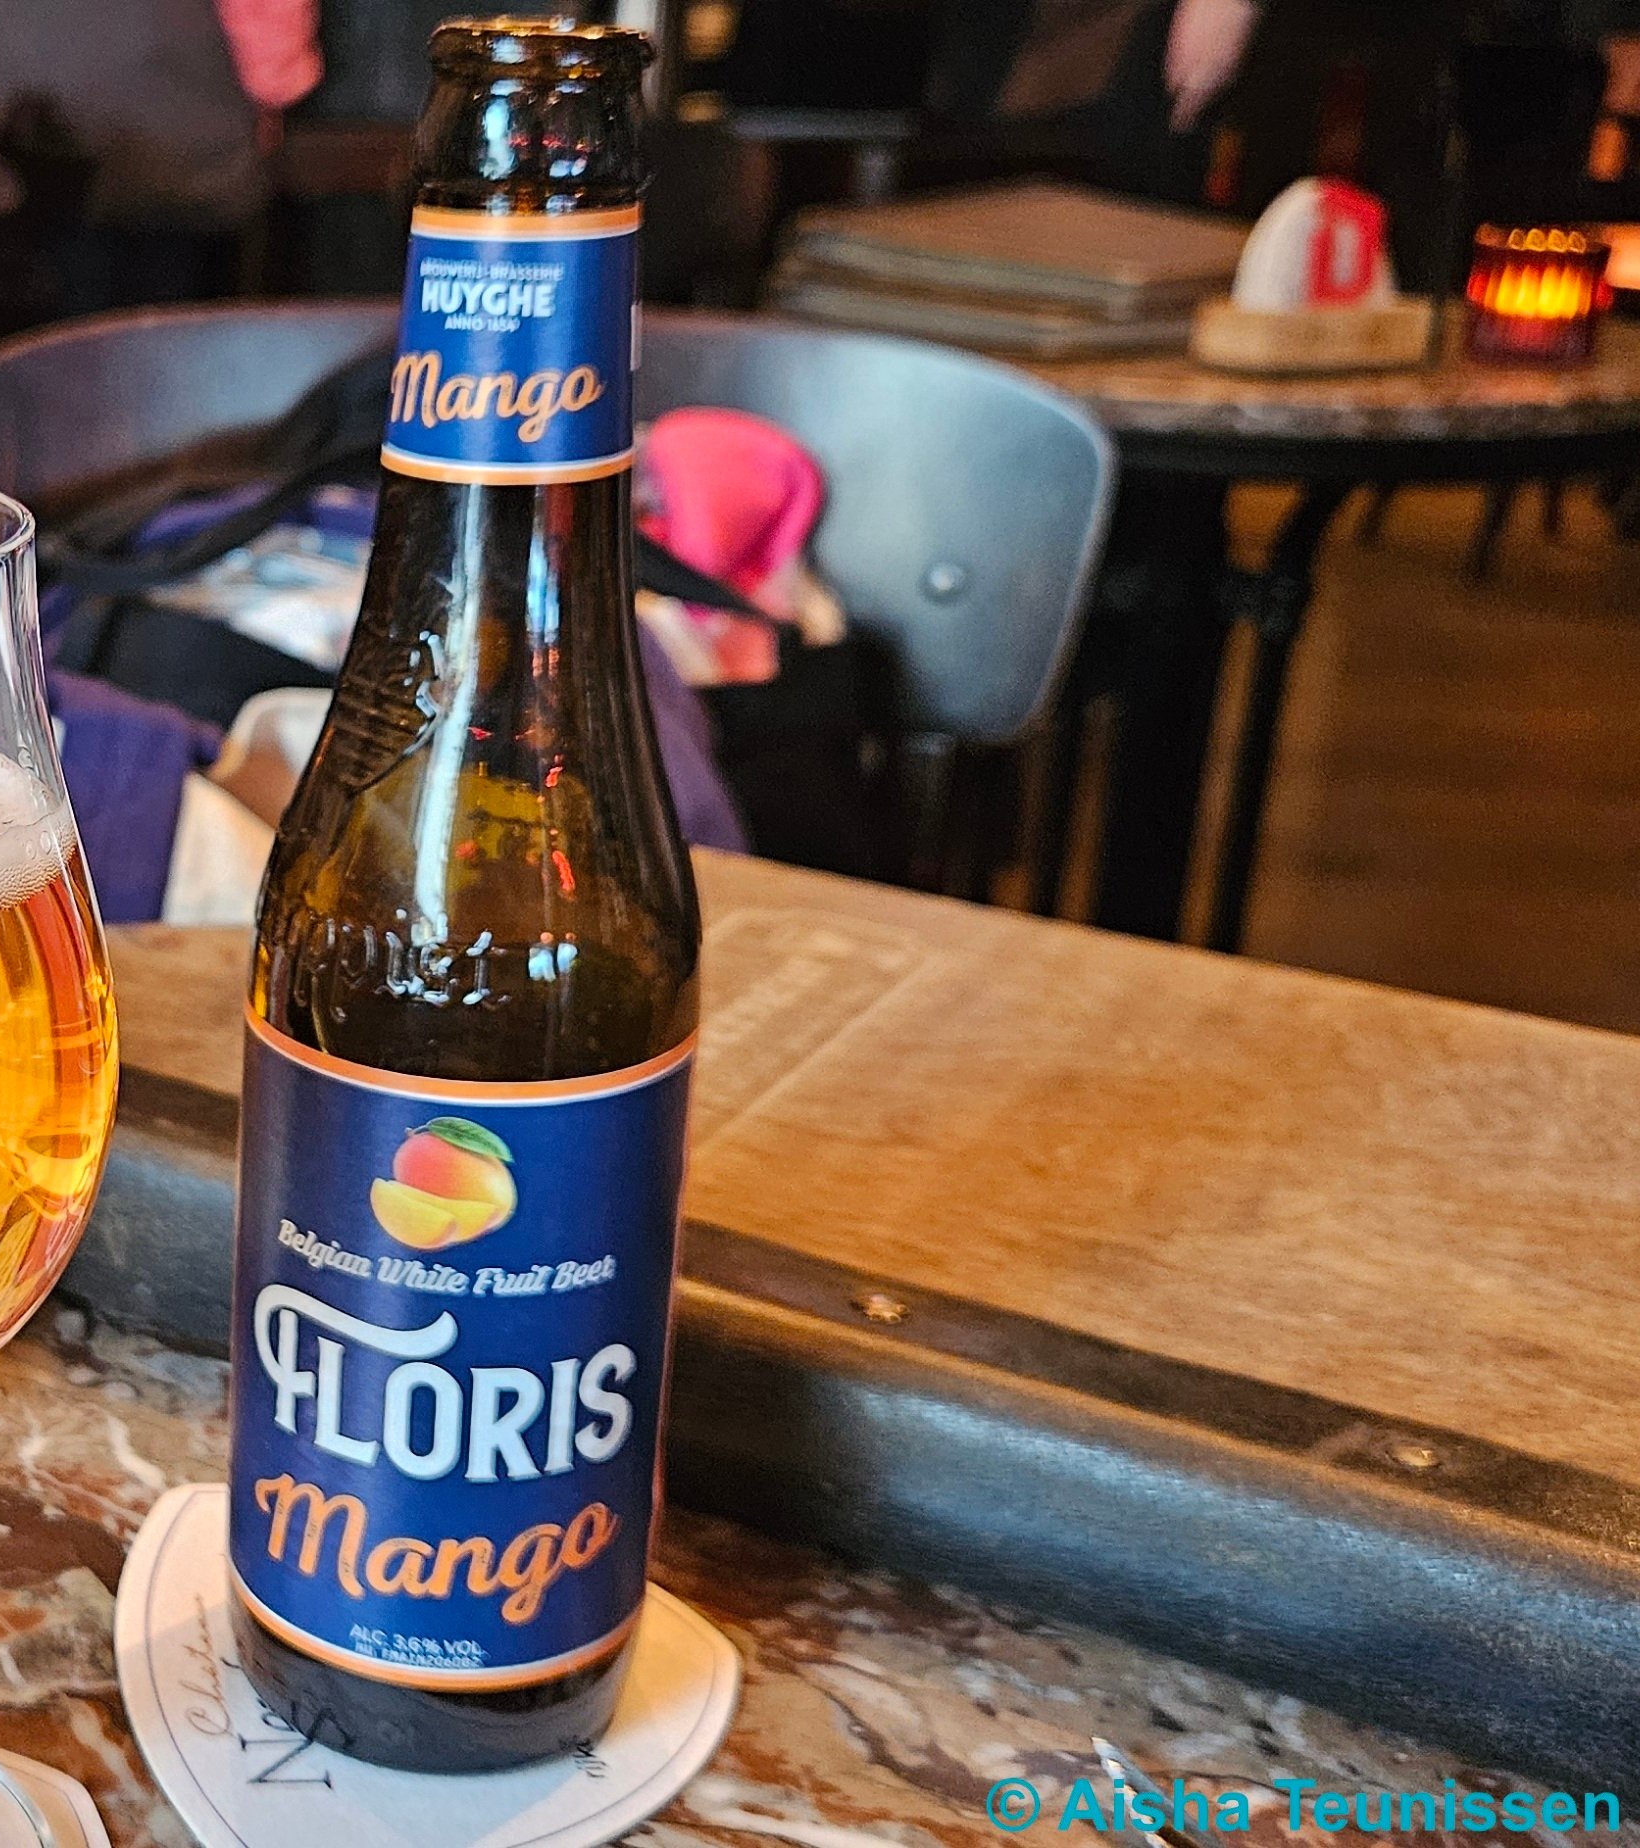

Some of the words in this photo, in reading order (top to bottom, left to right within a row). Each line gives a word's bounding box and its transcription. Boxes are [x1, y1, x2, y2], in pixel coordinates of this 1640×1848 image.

[422, 280, 557, 318] HUYGHE
[445, 314, 486, 332] ANNO
[390, 350, 605, 443] Mango
[277, 1218, 372, 1278] Belgian
[376, 1256, 469, 1294] White
[471, 1265, 556, 1298] Fruit
[551, 1254, 617, 1292] Beer
[254, 1282, 639, 1484] FLORIS
[254, 1472, 619, 1625] Mango
